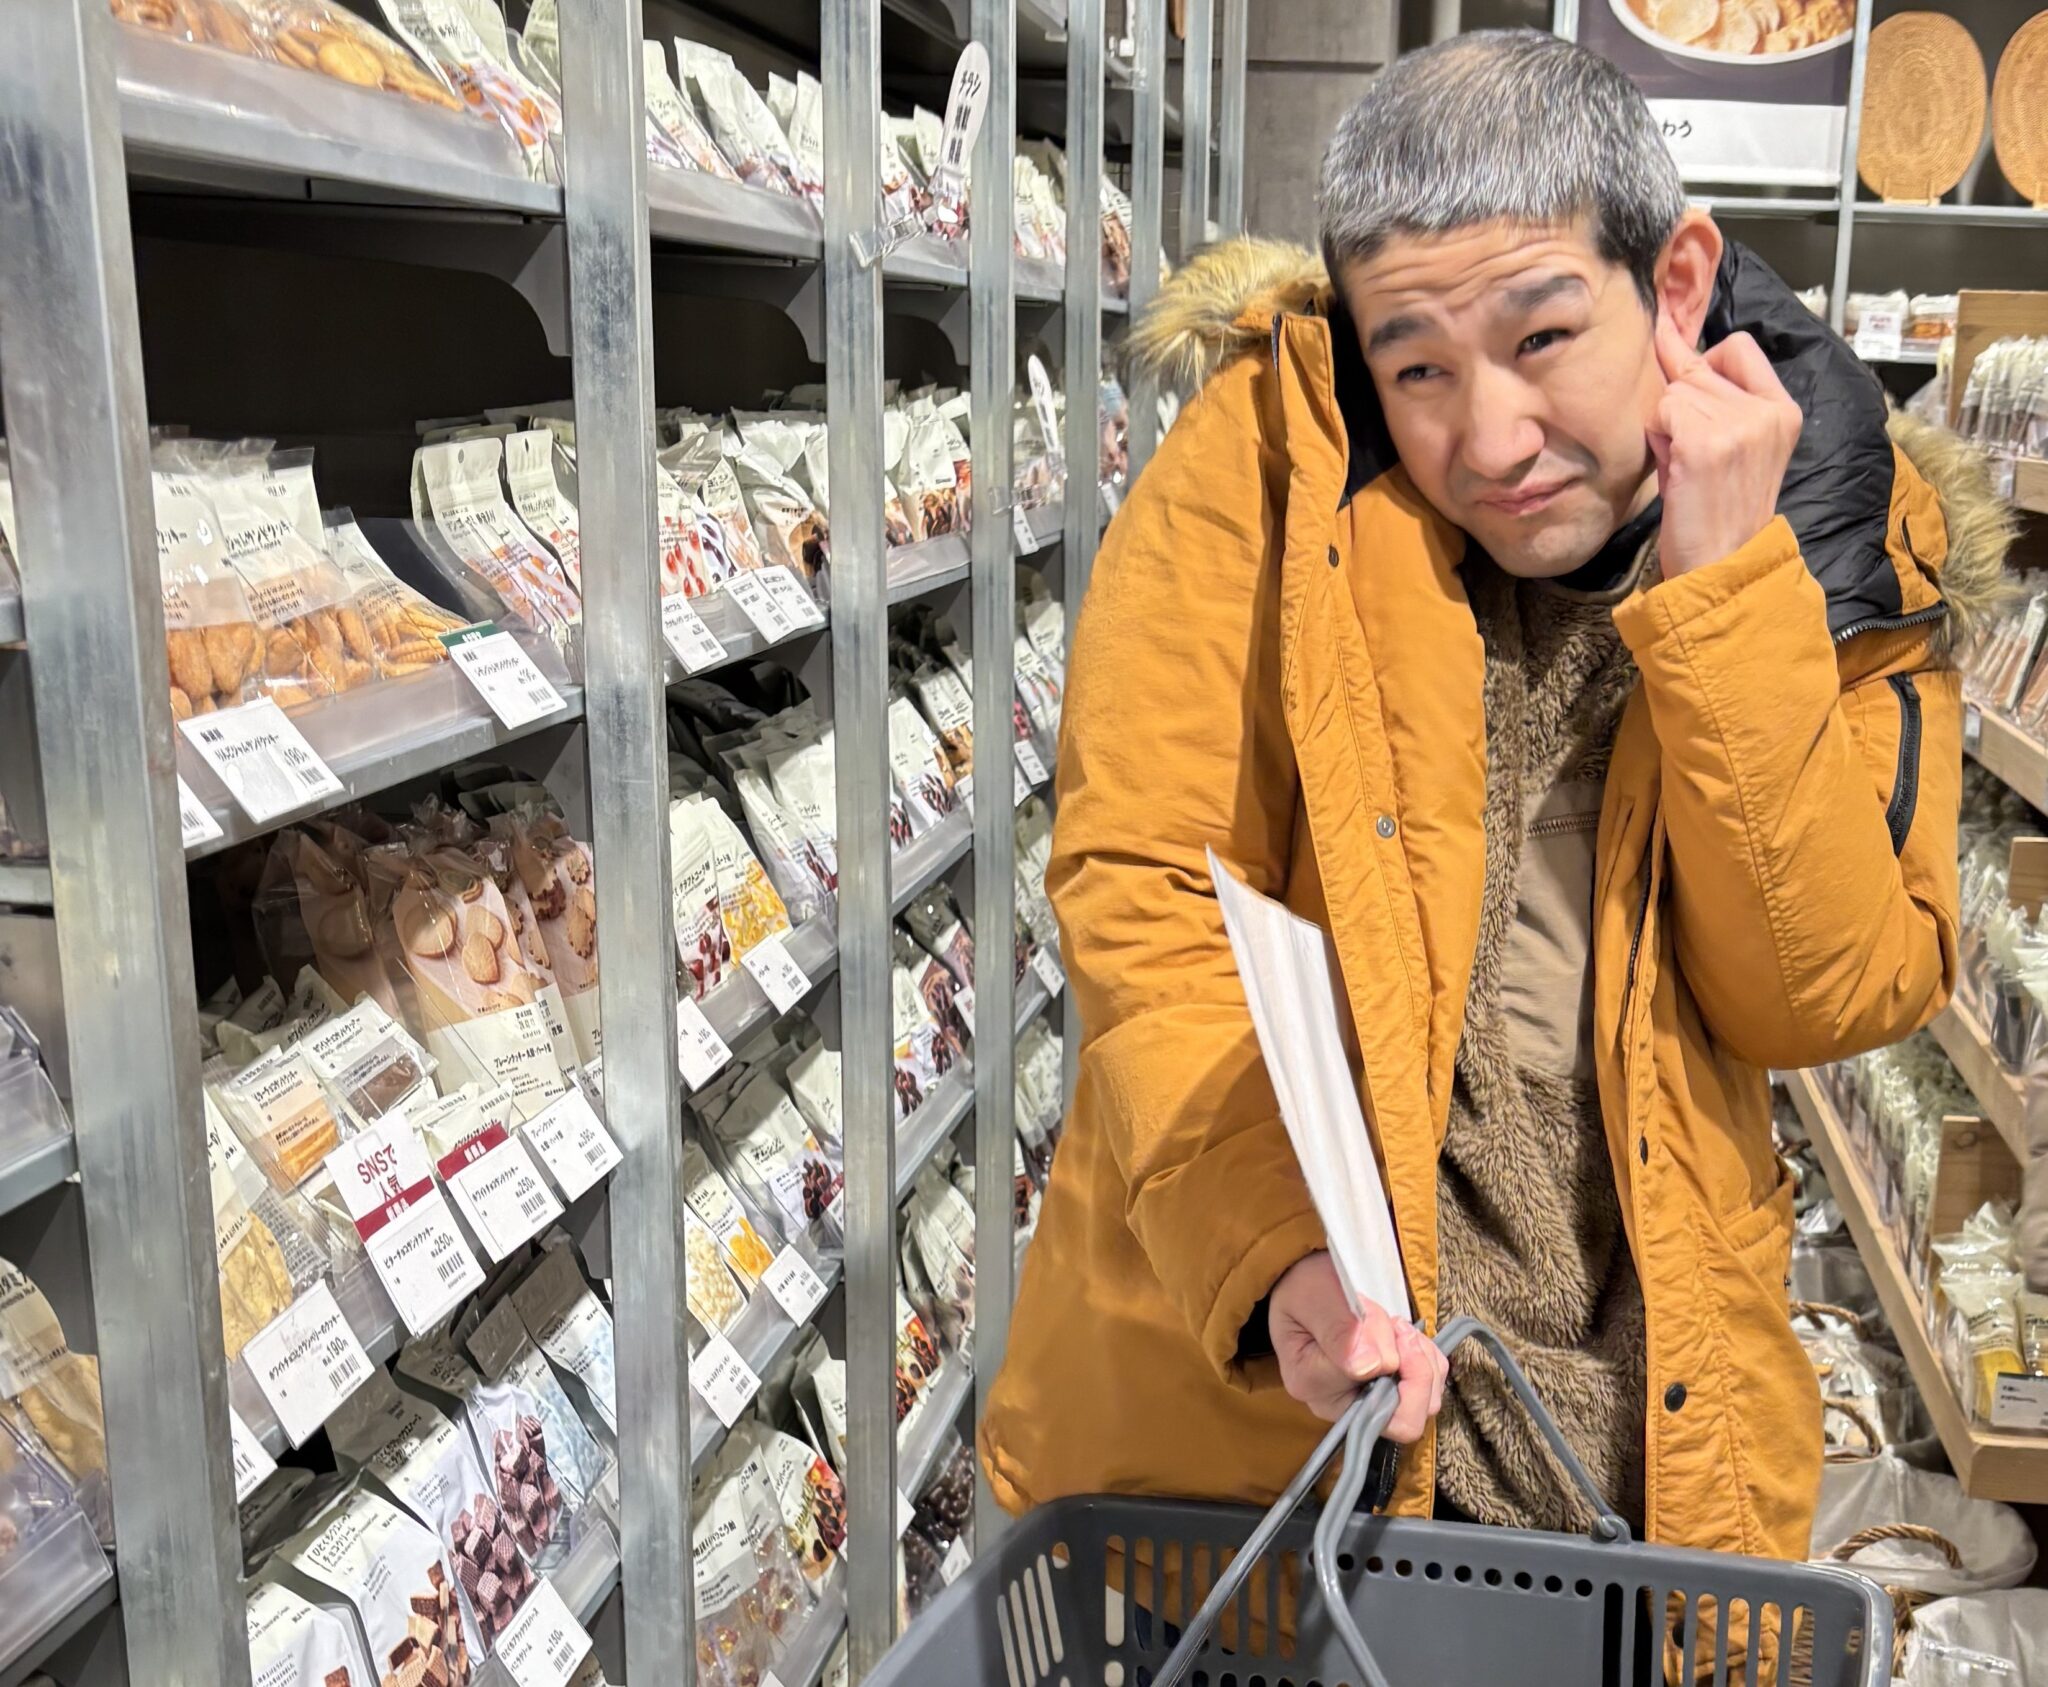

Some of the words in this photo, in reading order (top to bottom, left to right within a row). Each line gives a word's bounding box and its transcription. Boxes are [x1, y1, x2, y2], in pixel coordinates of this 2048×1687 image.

[357, 1143, 397, 1184] SNSで
[379, 1174, 404, 1203] 人気
[383, 1226, 434, 1269] ビターチョコサンドクッキー
[322, 1336, 349, 1367] 税込190円
